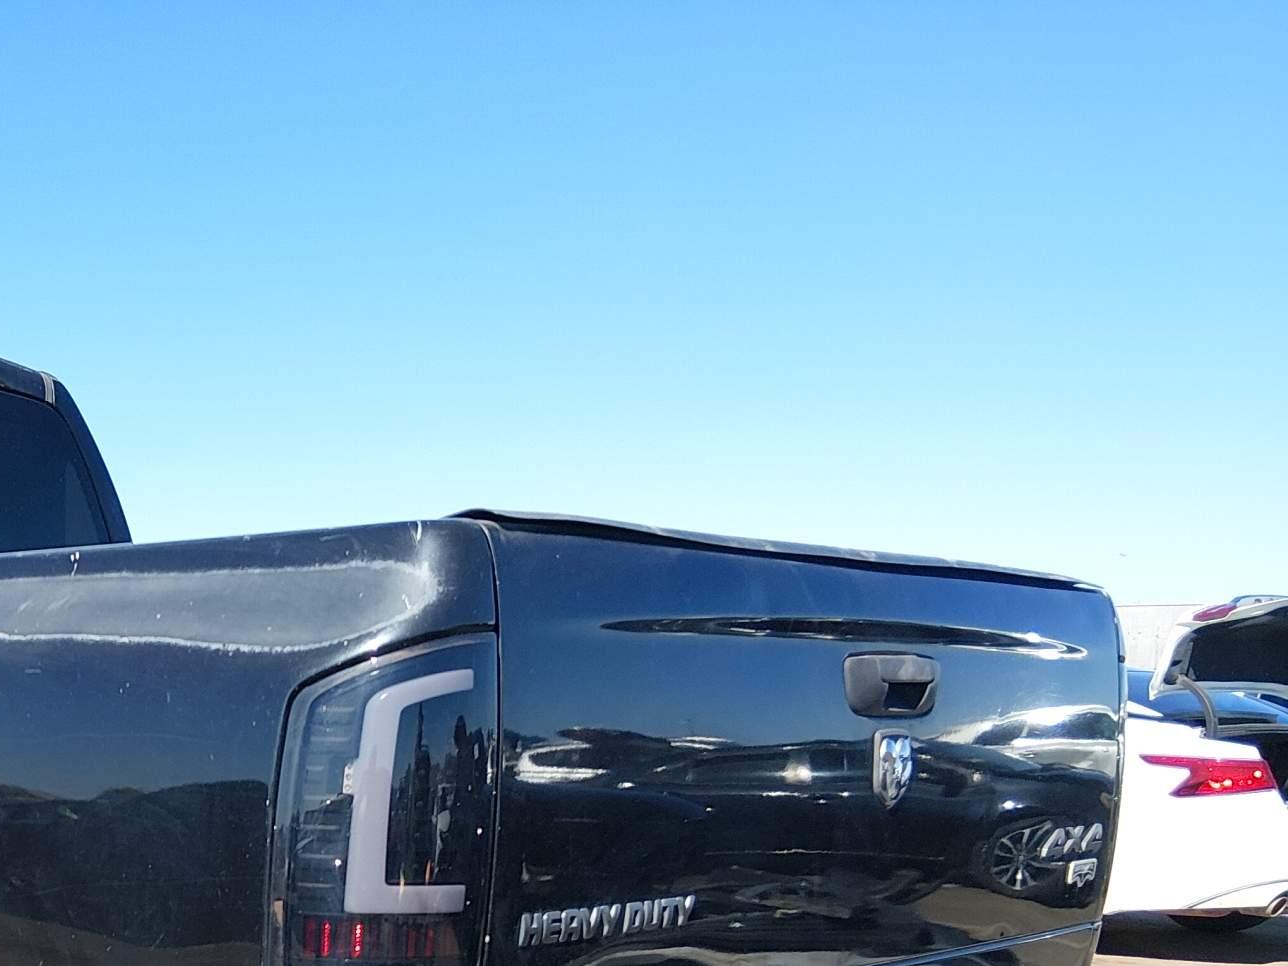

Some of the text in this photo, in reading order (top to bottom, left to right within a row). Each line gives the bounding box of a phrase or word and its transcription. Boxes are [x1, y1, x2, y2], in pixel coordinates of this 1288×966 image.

[1039, 823, 1103, 858] 4X4
[518, 895, 696, 947] HEAVY DUTY
